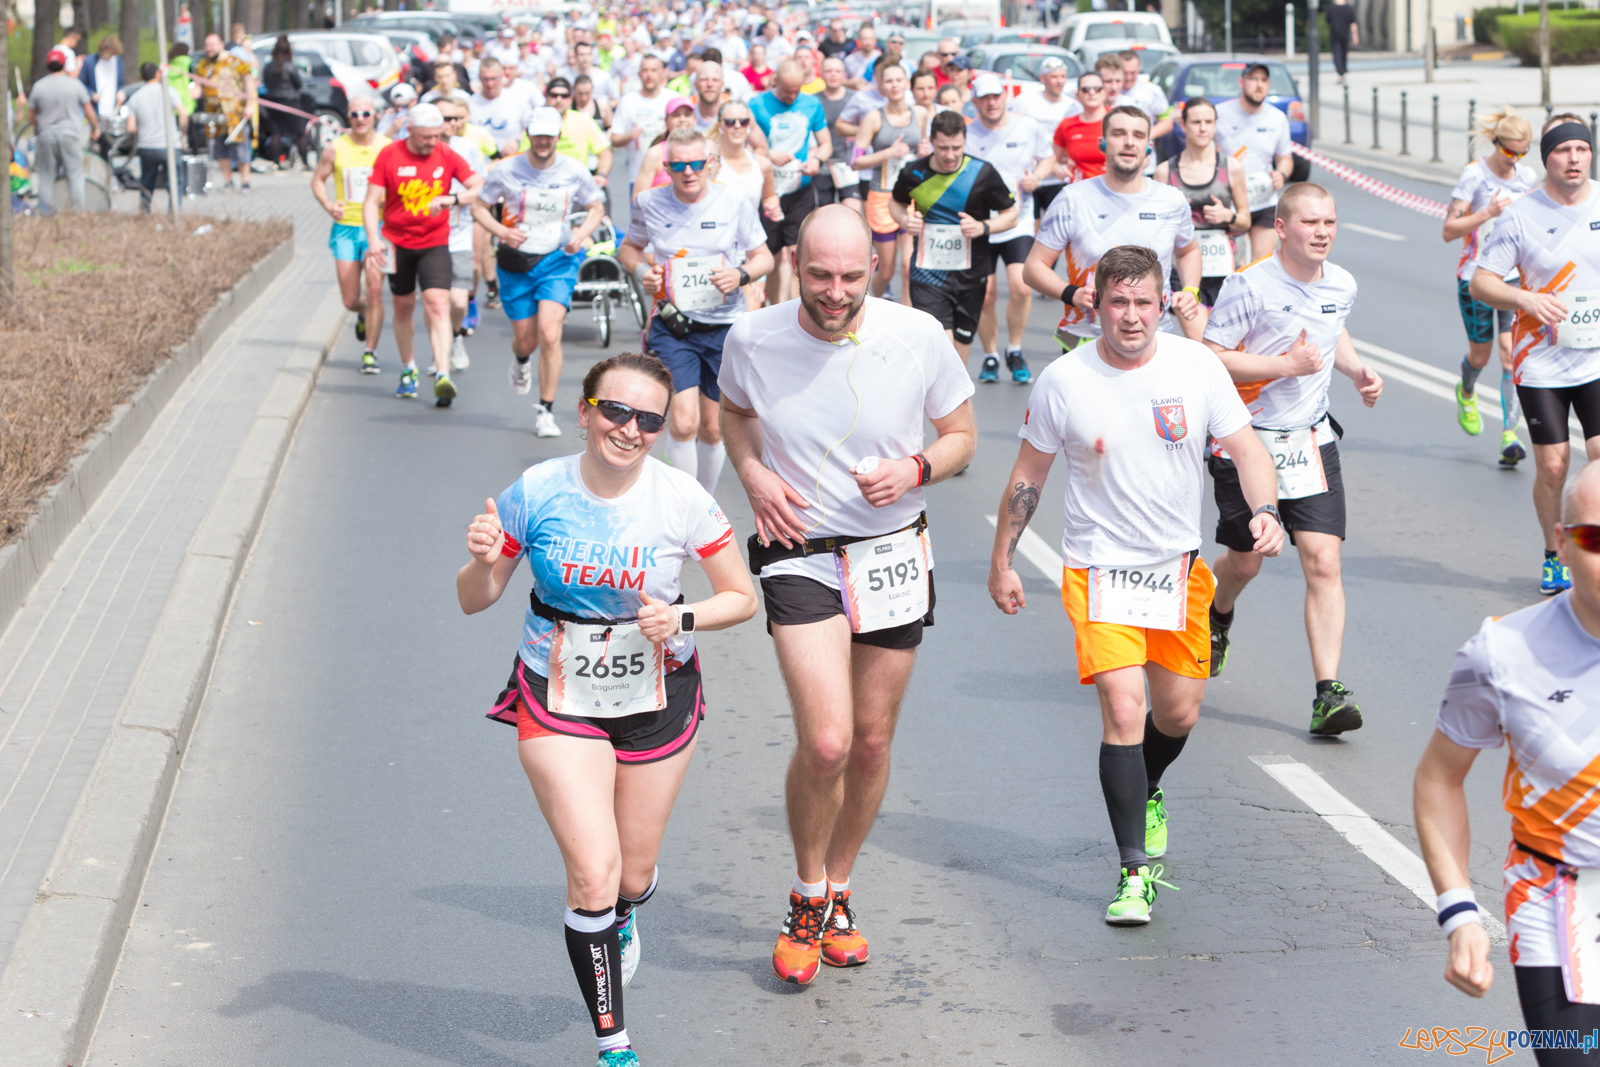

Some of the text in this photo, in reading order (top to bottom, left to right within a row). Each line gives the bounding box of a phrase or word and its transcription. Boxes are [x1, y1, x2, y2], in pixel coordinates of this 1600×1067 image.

[928, 238, 963, 251] 7408
[1165, 443, 1184, 451] 1317
[1270, 450, 1309, 470] 244
[547, 536, 658, 569] HERNIK
[561, 562, 646, 591] TEAM
[868, 557, 919, 592] 5193
[1108, 569, 1174, 594] 11944
[574, 652, 645, 679] 2655
